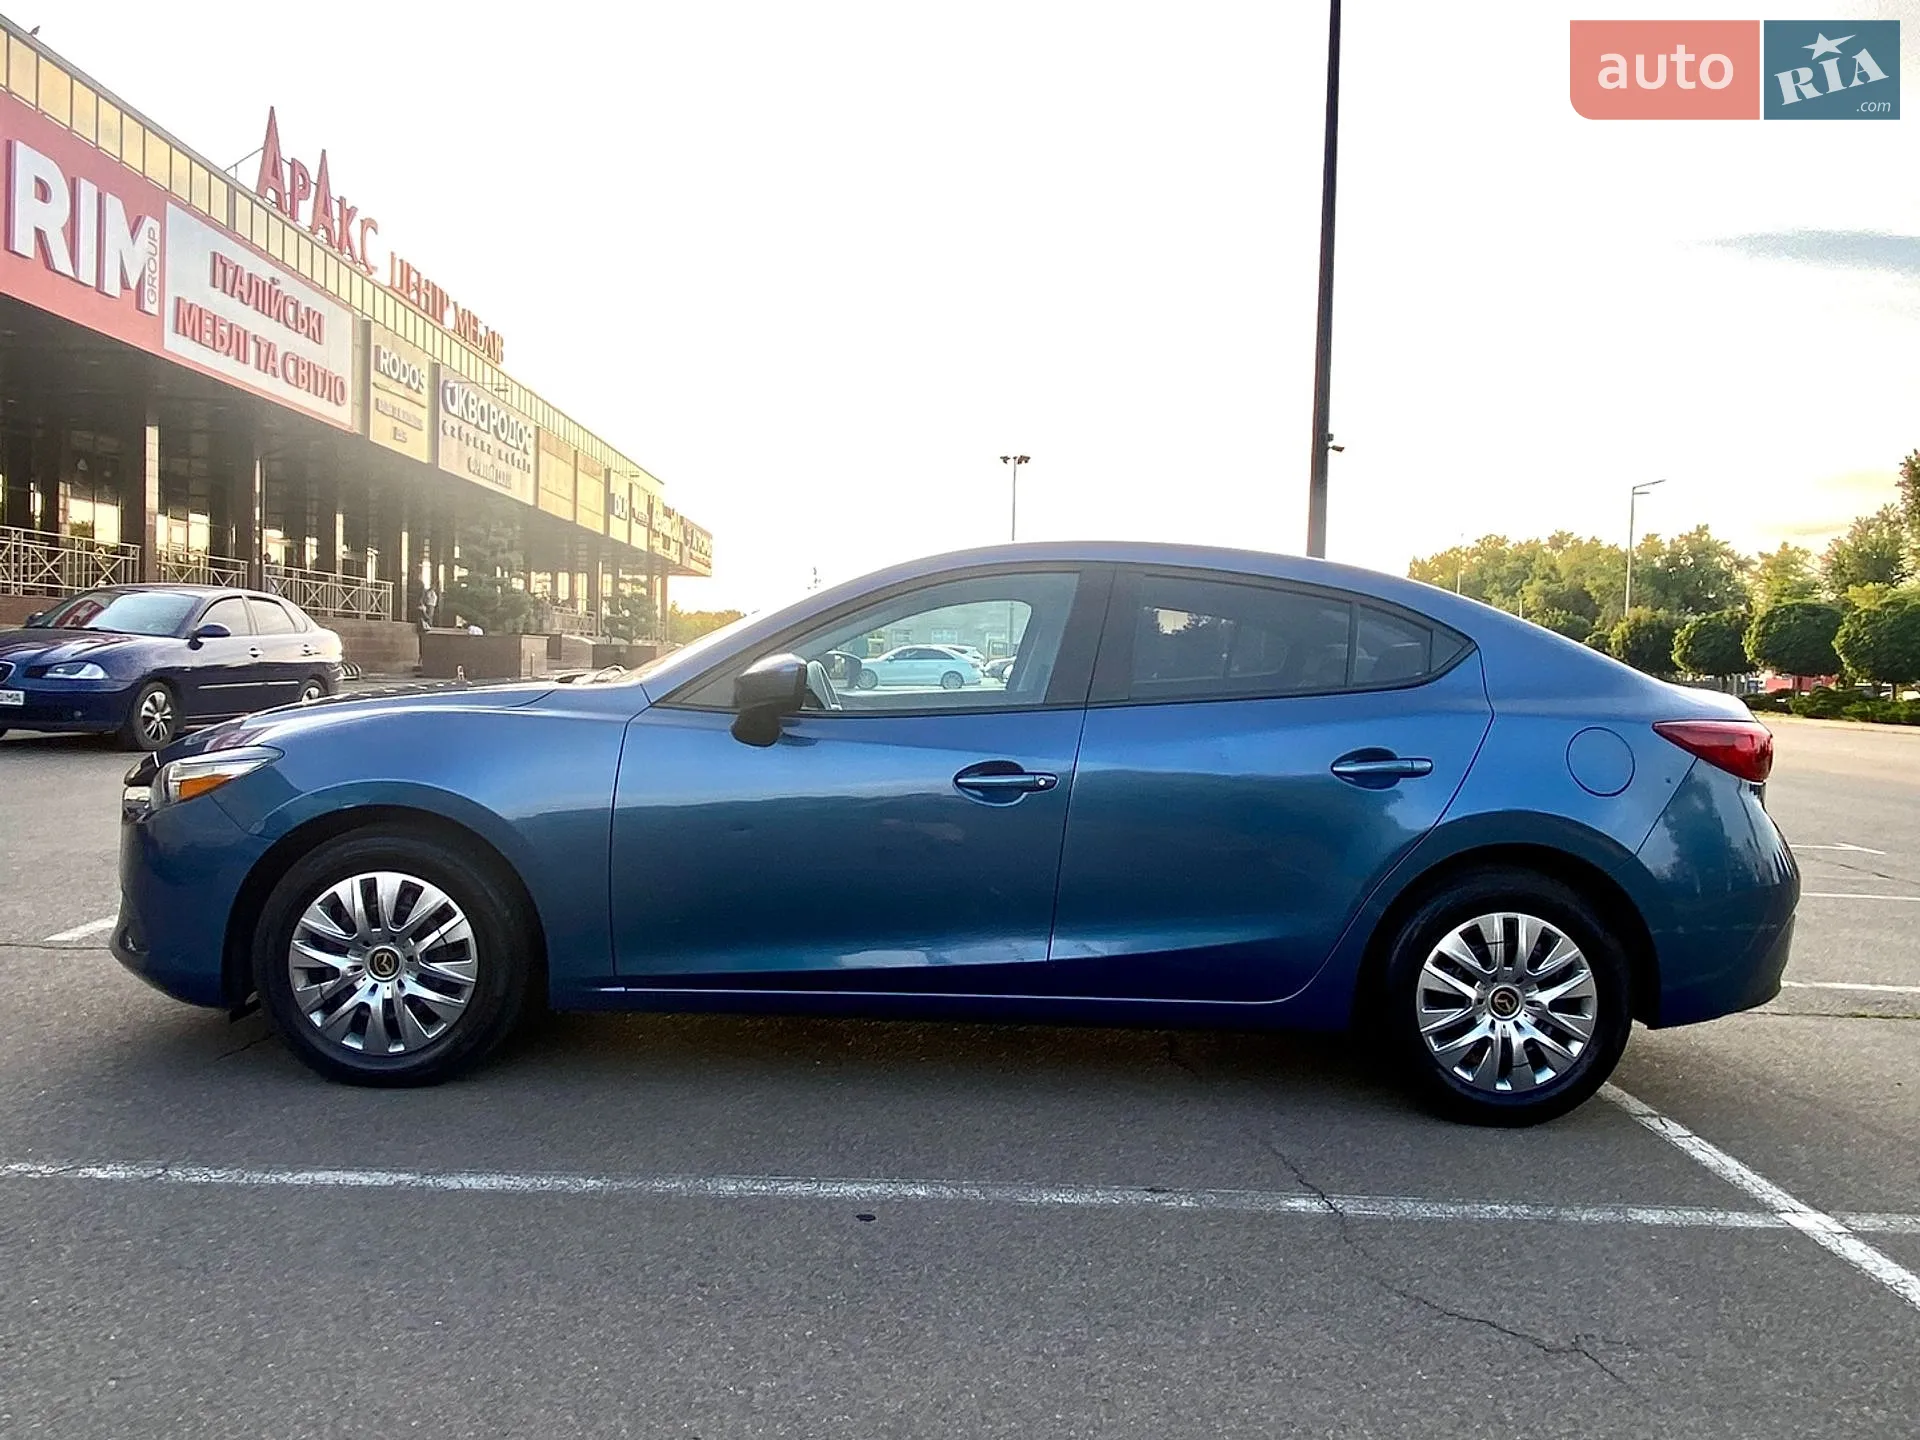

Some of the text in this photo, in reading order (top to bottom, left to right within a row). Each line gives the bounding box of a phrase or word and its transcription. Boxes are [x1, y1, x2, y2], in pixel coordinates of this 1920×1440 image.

[7, 140, 160, 317] RIM
[146, 226, 159, 305] GROUP
[210, 251, 325, 345] ІТАЛІЙСЬКІ
[174, 296, 347, 406] МЕБЛІ ТА СВІТЛО
[377, 346, 427, 395] RODOS
